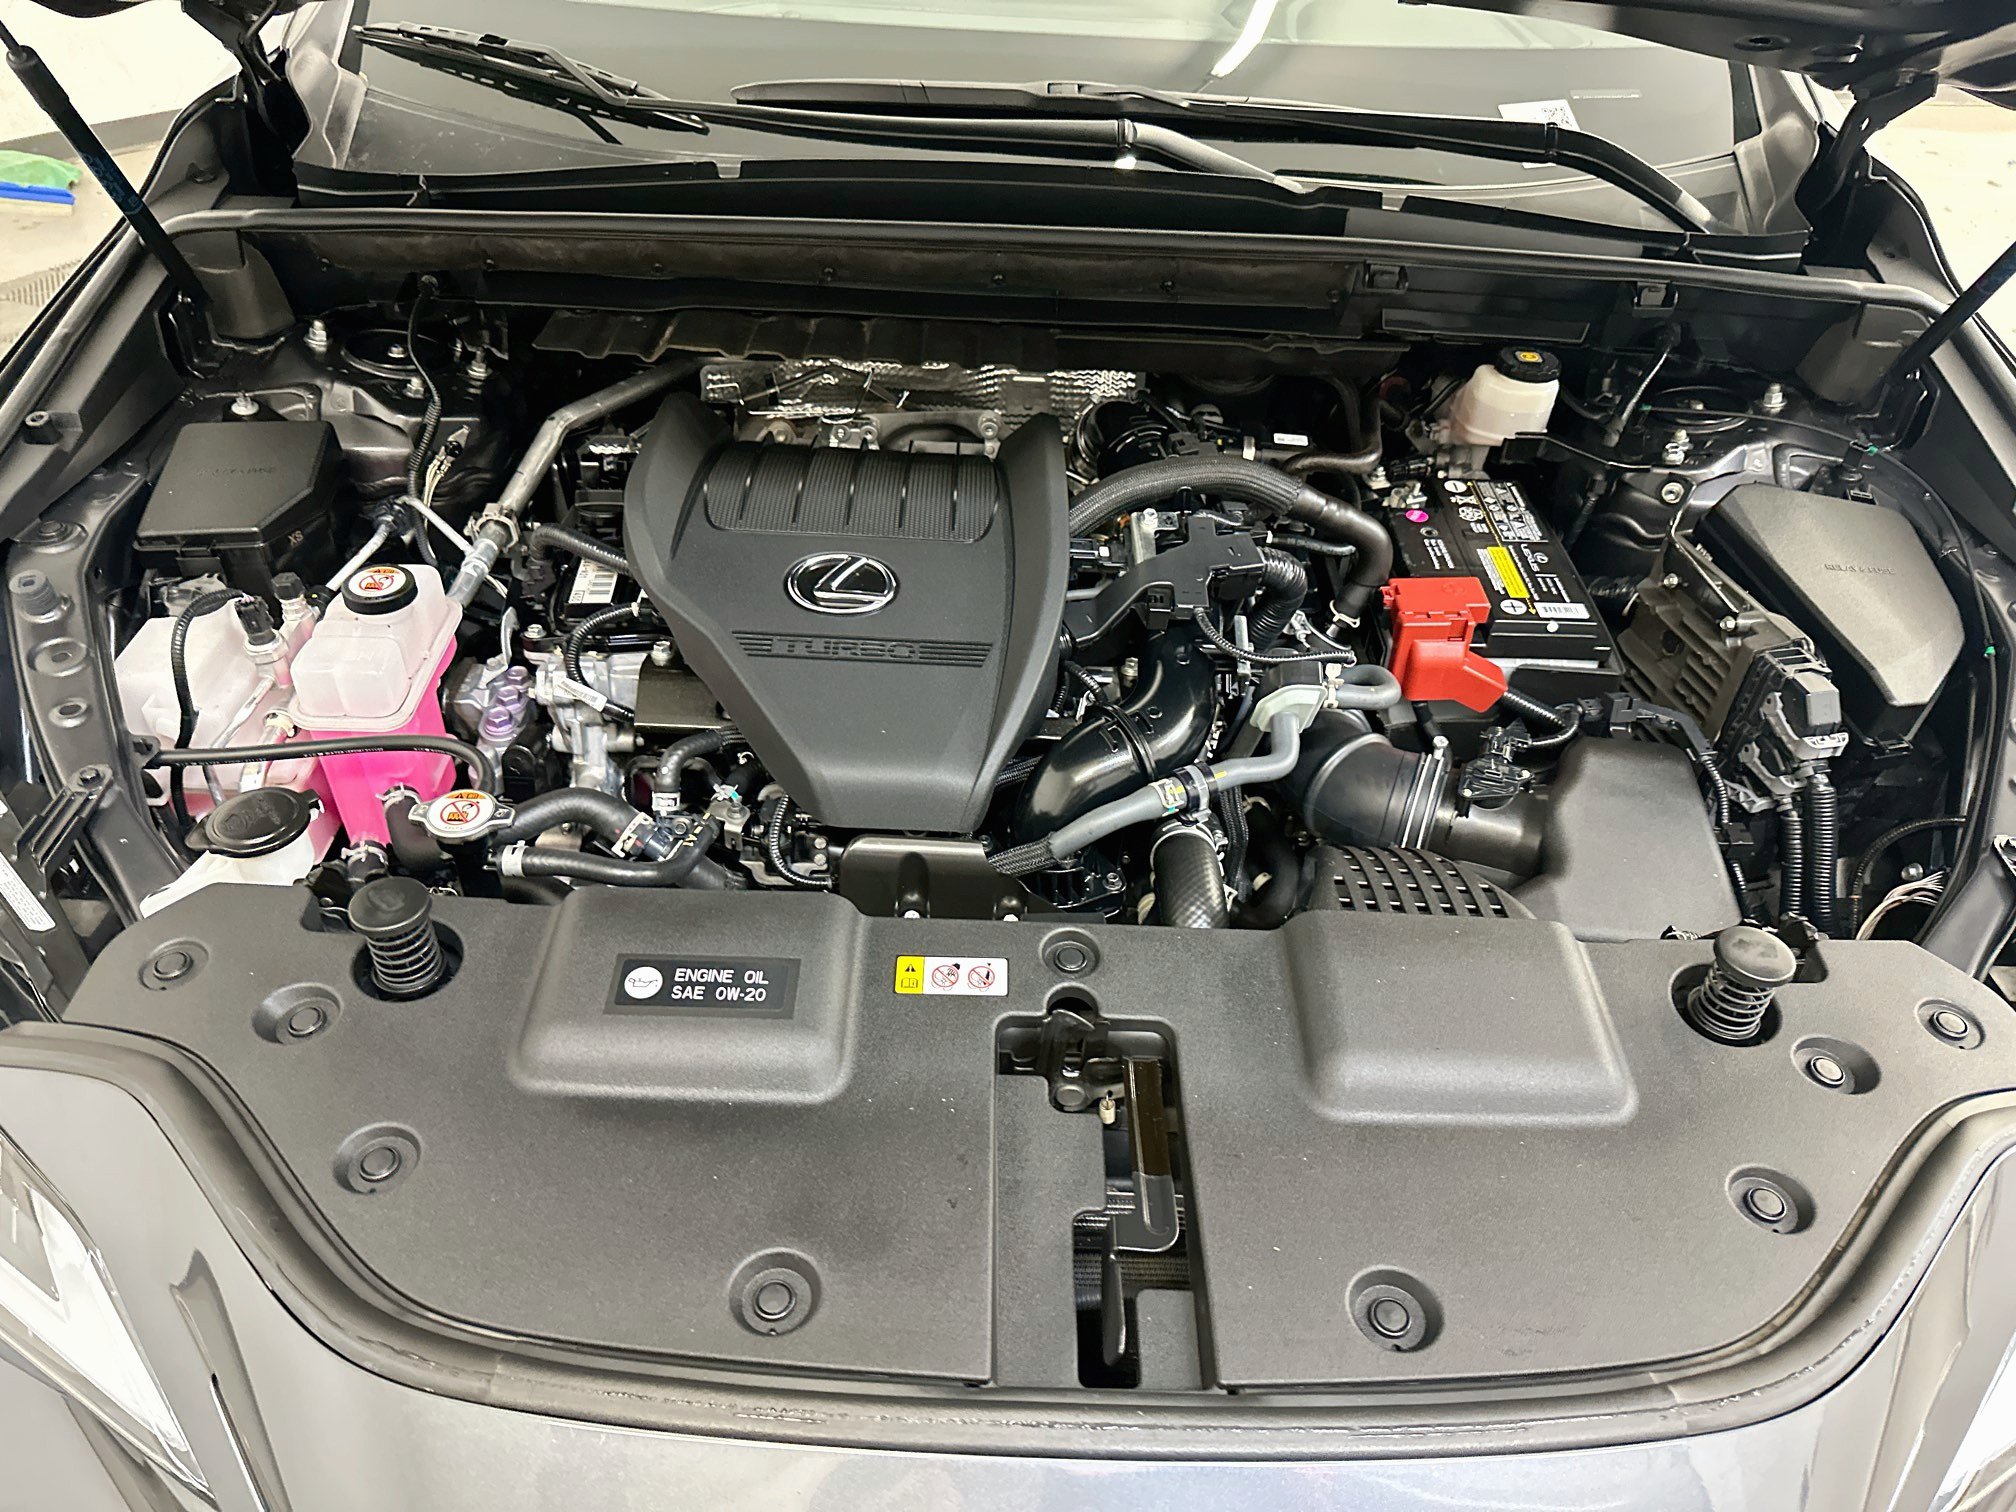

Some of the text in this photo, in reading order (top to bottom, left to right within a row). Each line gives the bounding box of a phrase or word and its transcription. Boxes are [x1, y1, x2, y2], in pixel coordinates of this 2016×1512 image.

[288, 530, 304, 546] XS
[1520, 543, 1541, 572] LEXUS
[775, 636, 918, 660] TURBO
[674, 967, 770, 985] ENGINE OIL
[671, 985, 767, 1002] SAE 0W-20
